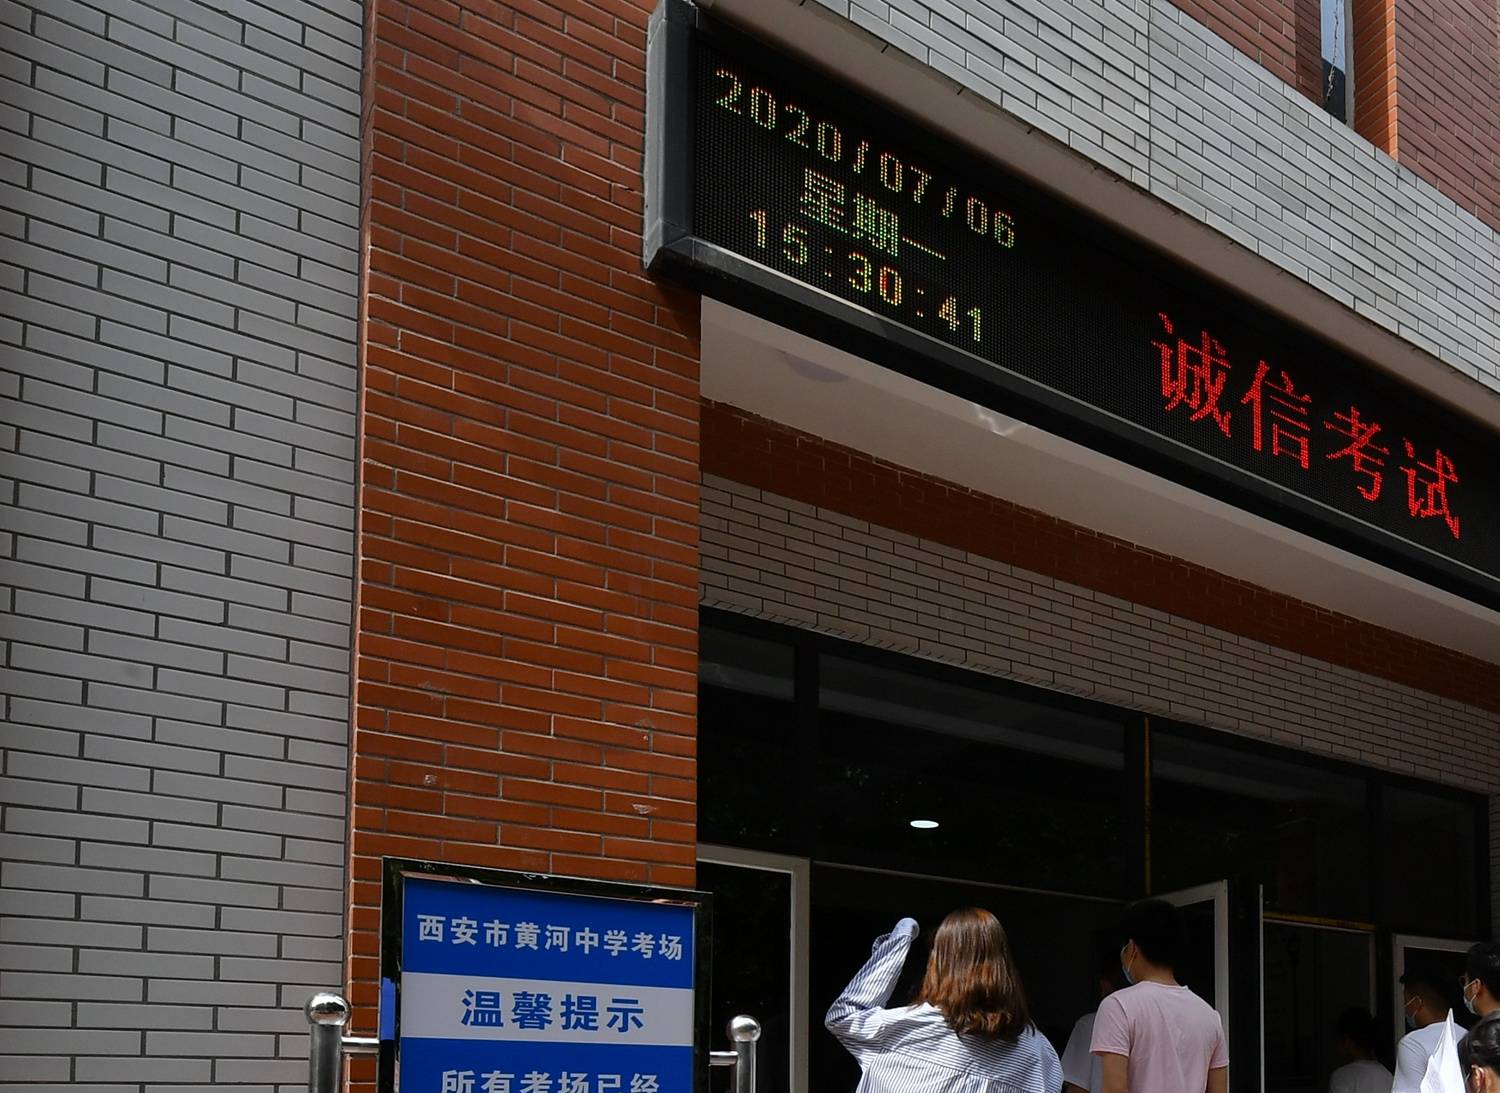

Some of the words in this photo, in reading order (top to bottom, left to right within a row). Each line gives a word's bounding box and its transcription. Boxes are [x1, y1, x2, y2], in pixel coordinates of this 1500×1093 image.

[716, 68, 1016, 248] 2020/07/06
[800, 168, 946, 260] 星期一
[749, 208, 981, 342] 15:30:41
[1151, 312, 1461, 539] 诚信考试
[416, 914, 684, 961] 西安市黄河中学考场
[460, 988, 645, 1033] 温馨提示
